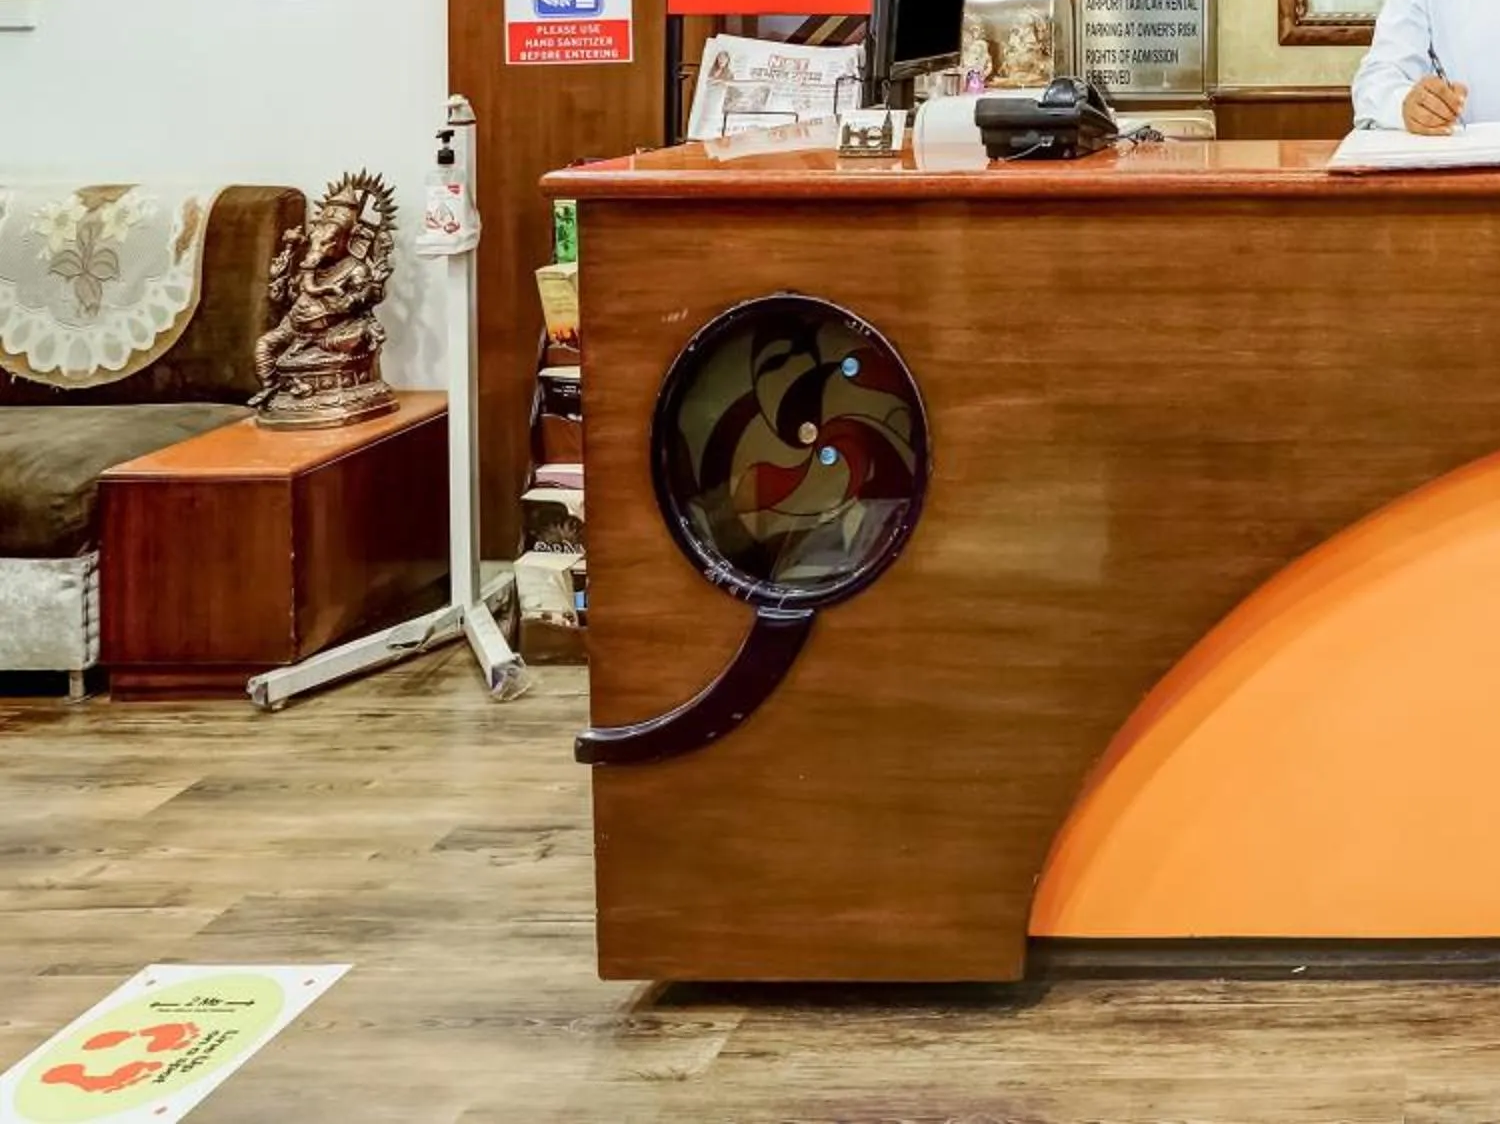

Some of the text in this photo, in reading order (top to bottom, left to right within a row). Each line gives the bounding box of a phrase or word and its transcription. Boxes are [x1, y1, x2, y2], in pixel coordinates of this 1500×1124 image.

[537, 25, 600, 35] PLEASE USE
[1085, 23, 1123, 36] PARKING
[1124, 23, 1135, 36] AT
[1178, 23, 1198, 37] RISK
[525, 37, 613, 48] HAND SANITIZER
[520, 49, 619, 61] BEFORE ENTERING
[1085, 49, 1179, 64] RIGHTS OF ADMISSION
[1085, 69, 1131, 85] RESERVED
